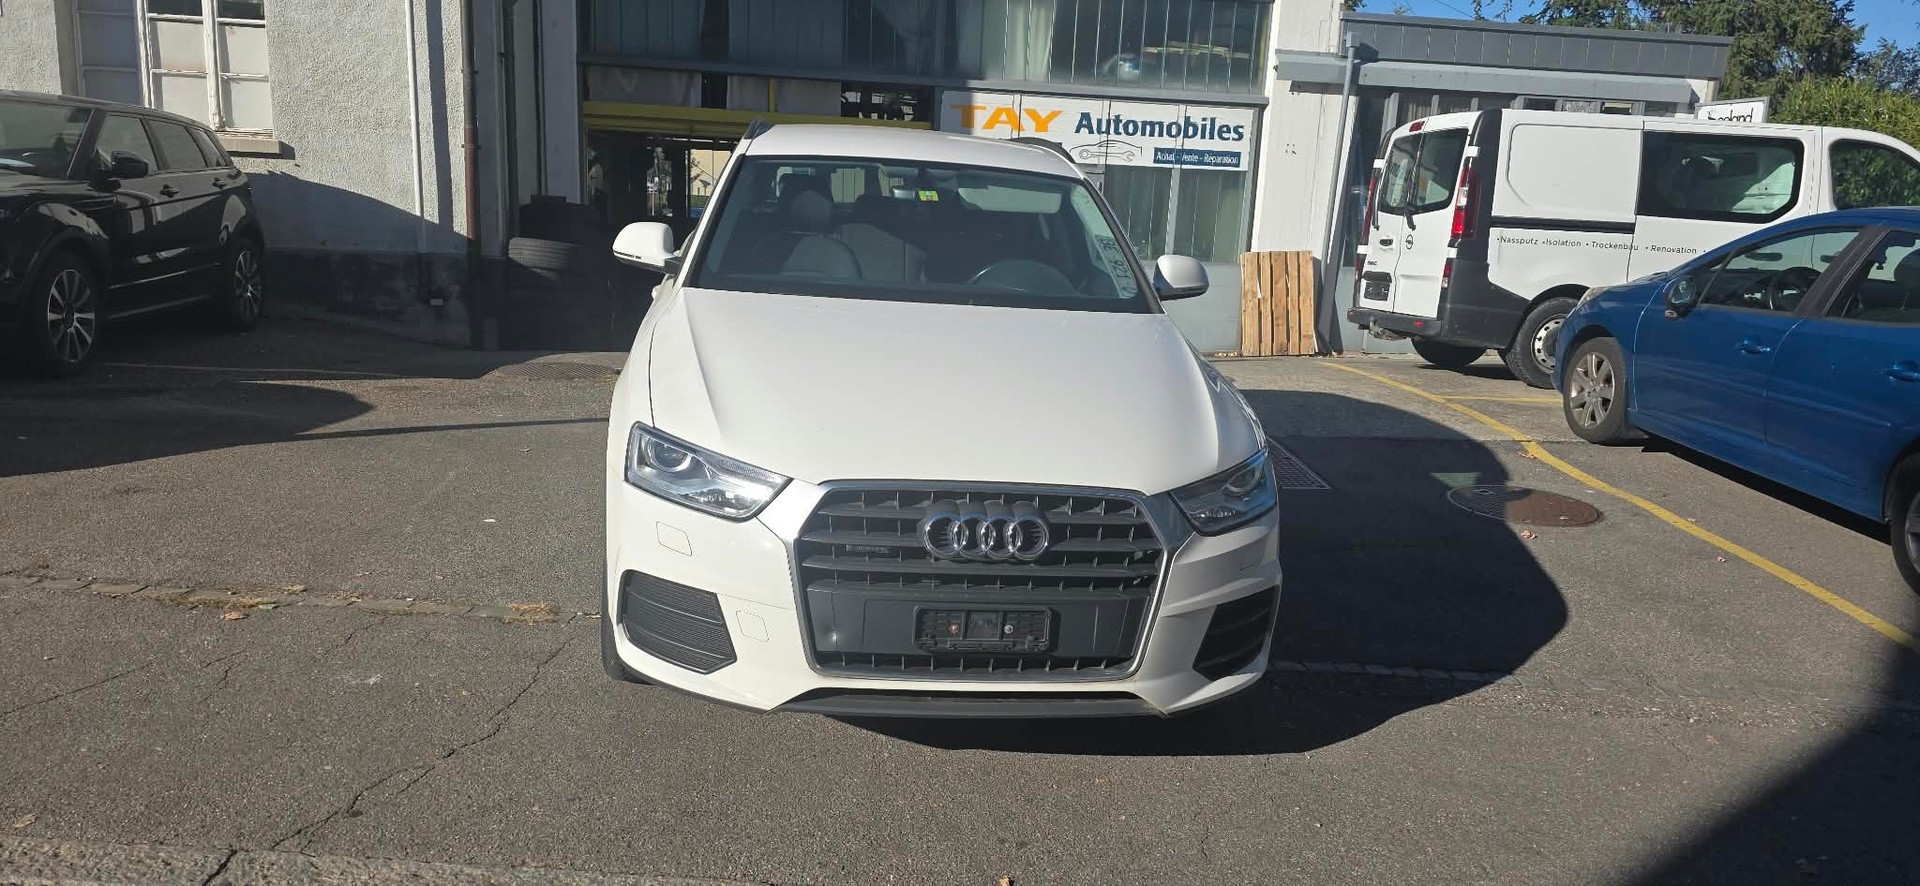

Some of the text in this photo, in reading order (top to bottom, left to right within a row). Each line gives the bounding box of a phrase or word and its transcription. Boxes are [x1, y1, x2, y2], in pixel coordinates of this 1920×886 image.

[950, 104, 1245, 142] TAY Automobiles
[1500, 236, 1697, 254] Nassputz Isolation Trockenbau Renovation
